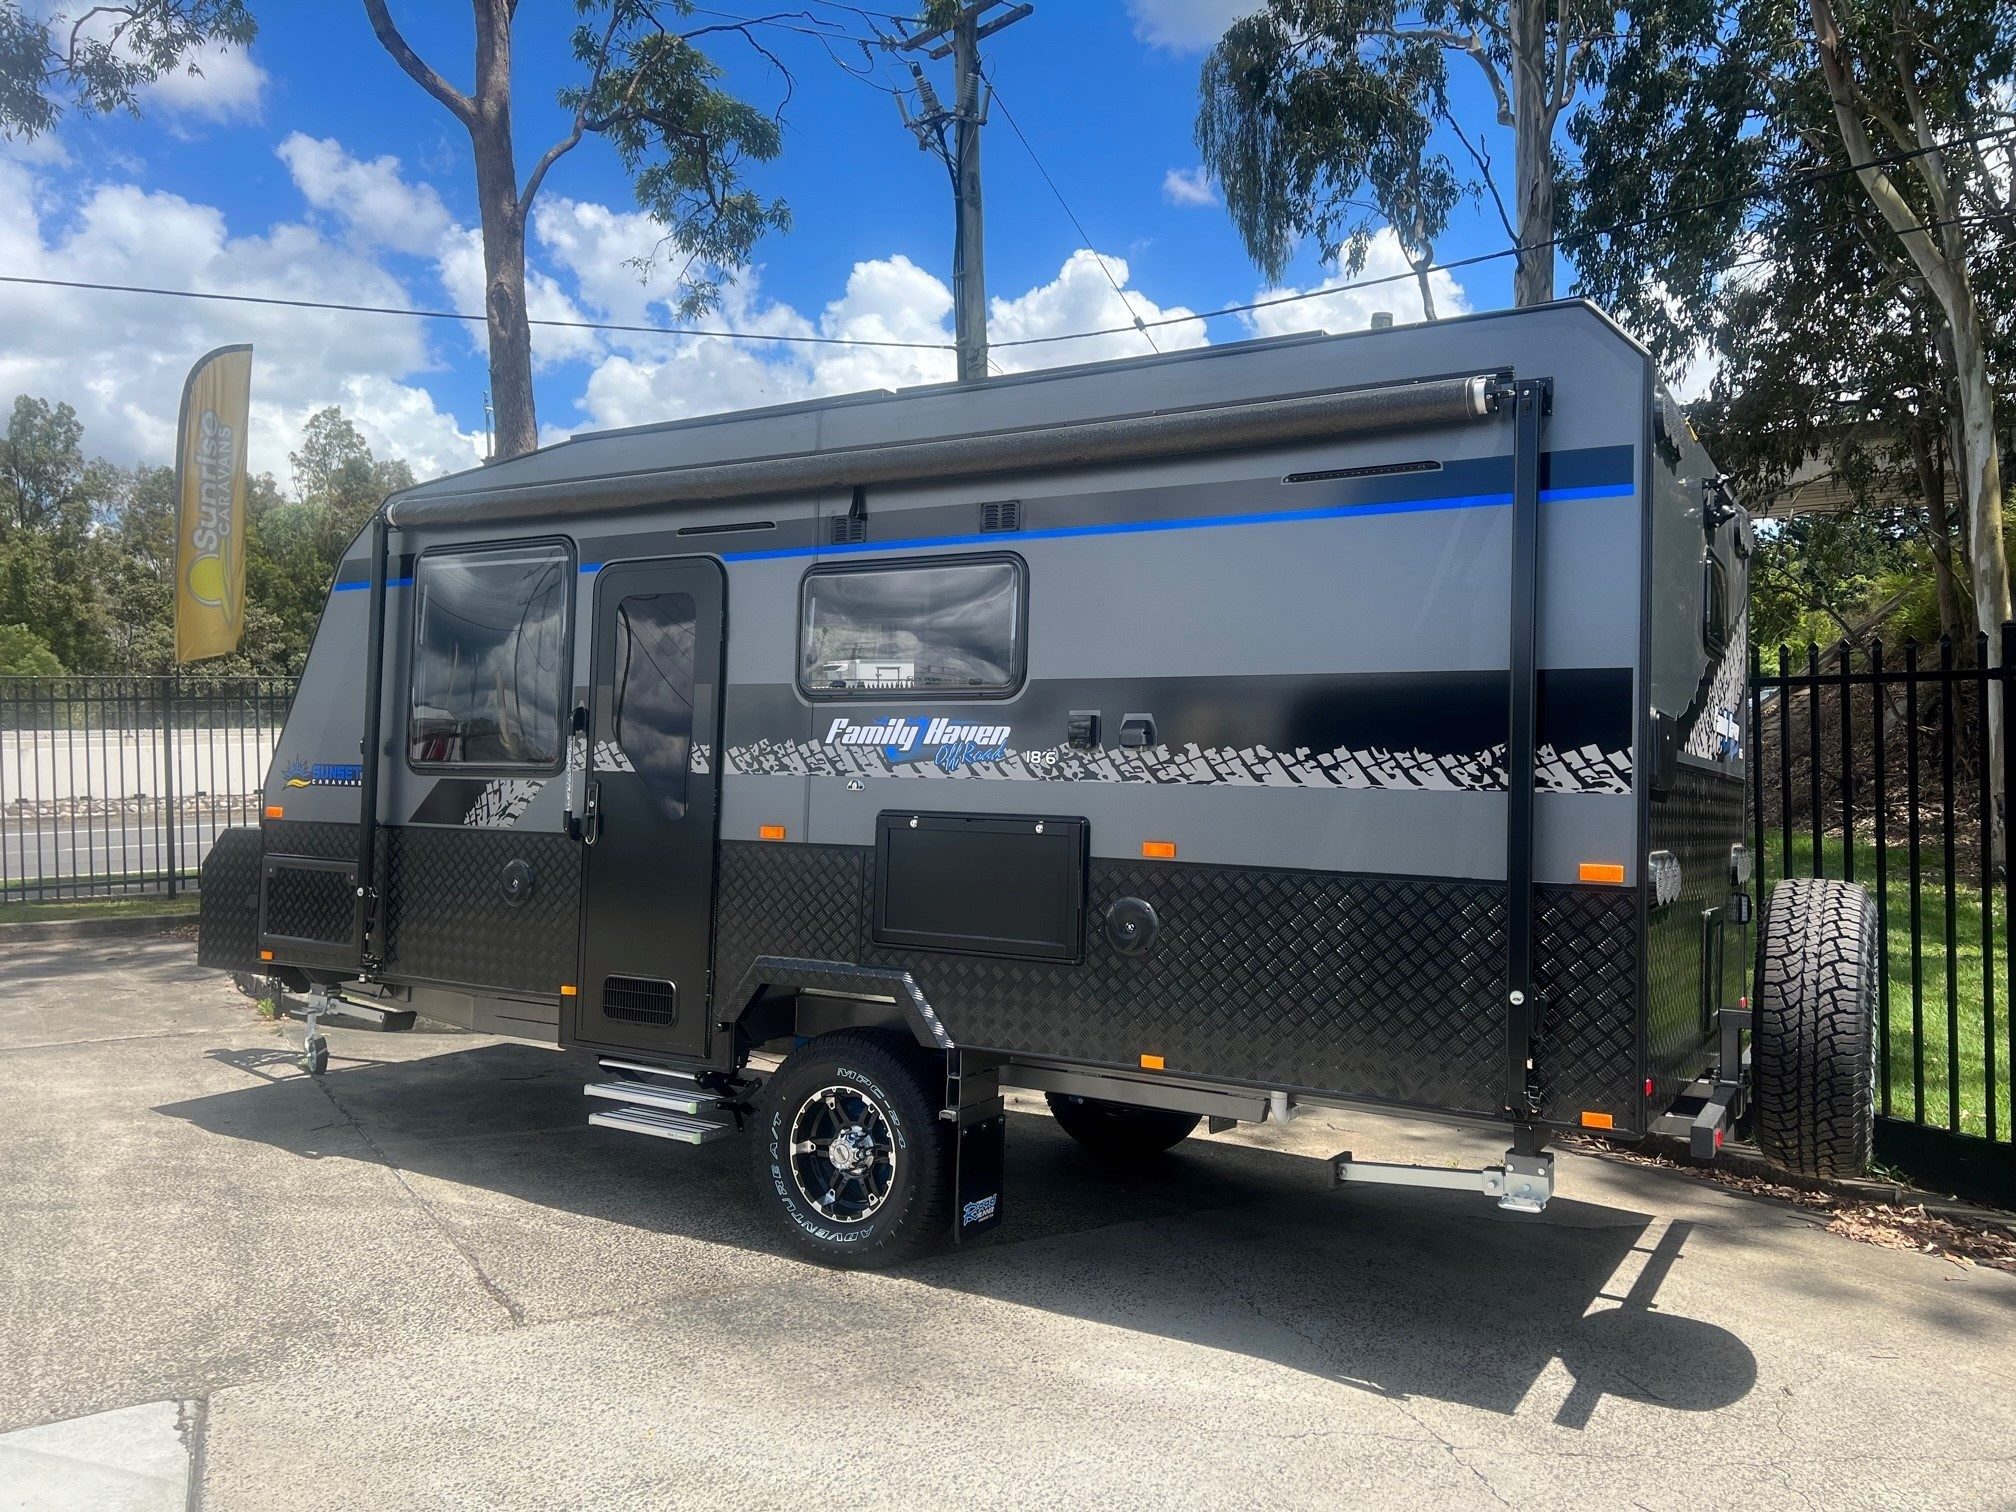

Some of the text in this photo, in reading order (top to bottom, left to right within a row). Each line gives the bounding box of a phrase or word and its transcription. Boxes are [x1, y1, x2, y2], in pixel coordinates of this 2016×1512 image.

[193, 411, 219, 551] Sunrise
[217, 427, 232, 536] CARAVANS
[825, 717, 1011, 751] Family Haven
[311, 779, 362, 787] CARAVANS
[312, 764, 363, 780] SUNSET
[770, 1164, 875, 1242] ADVENTURE
